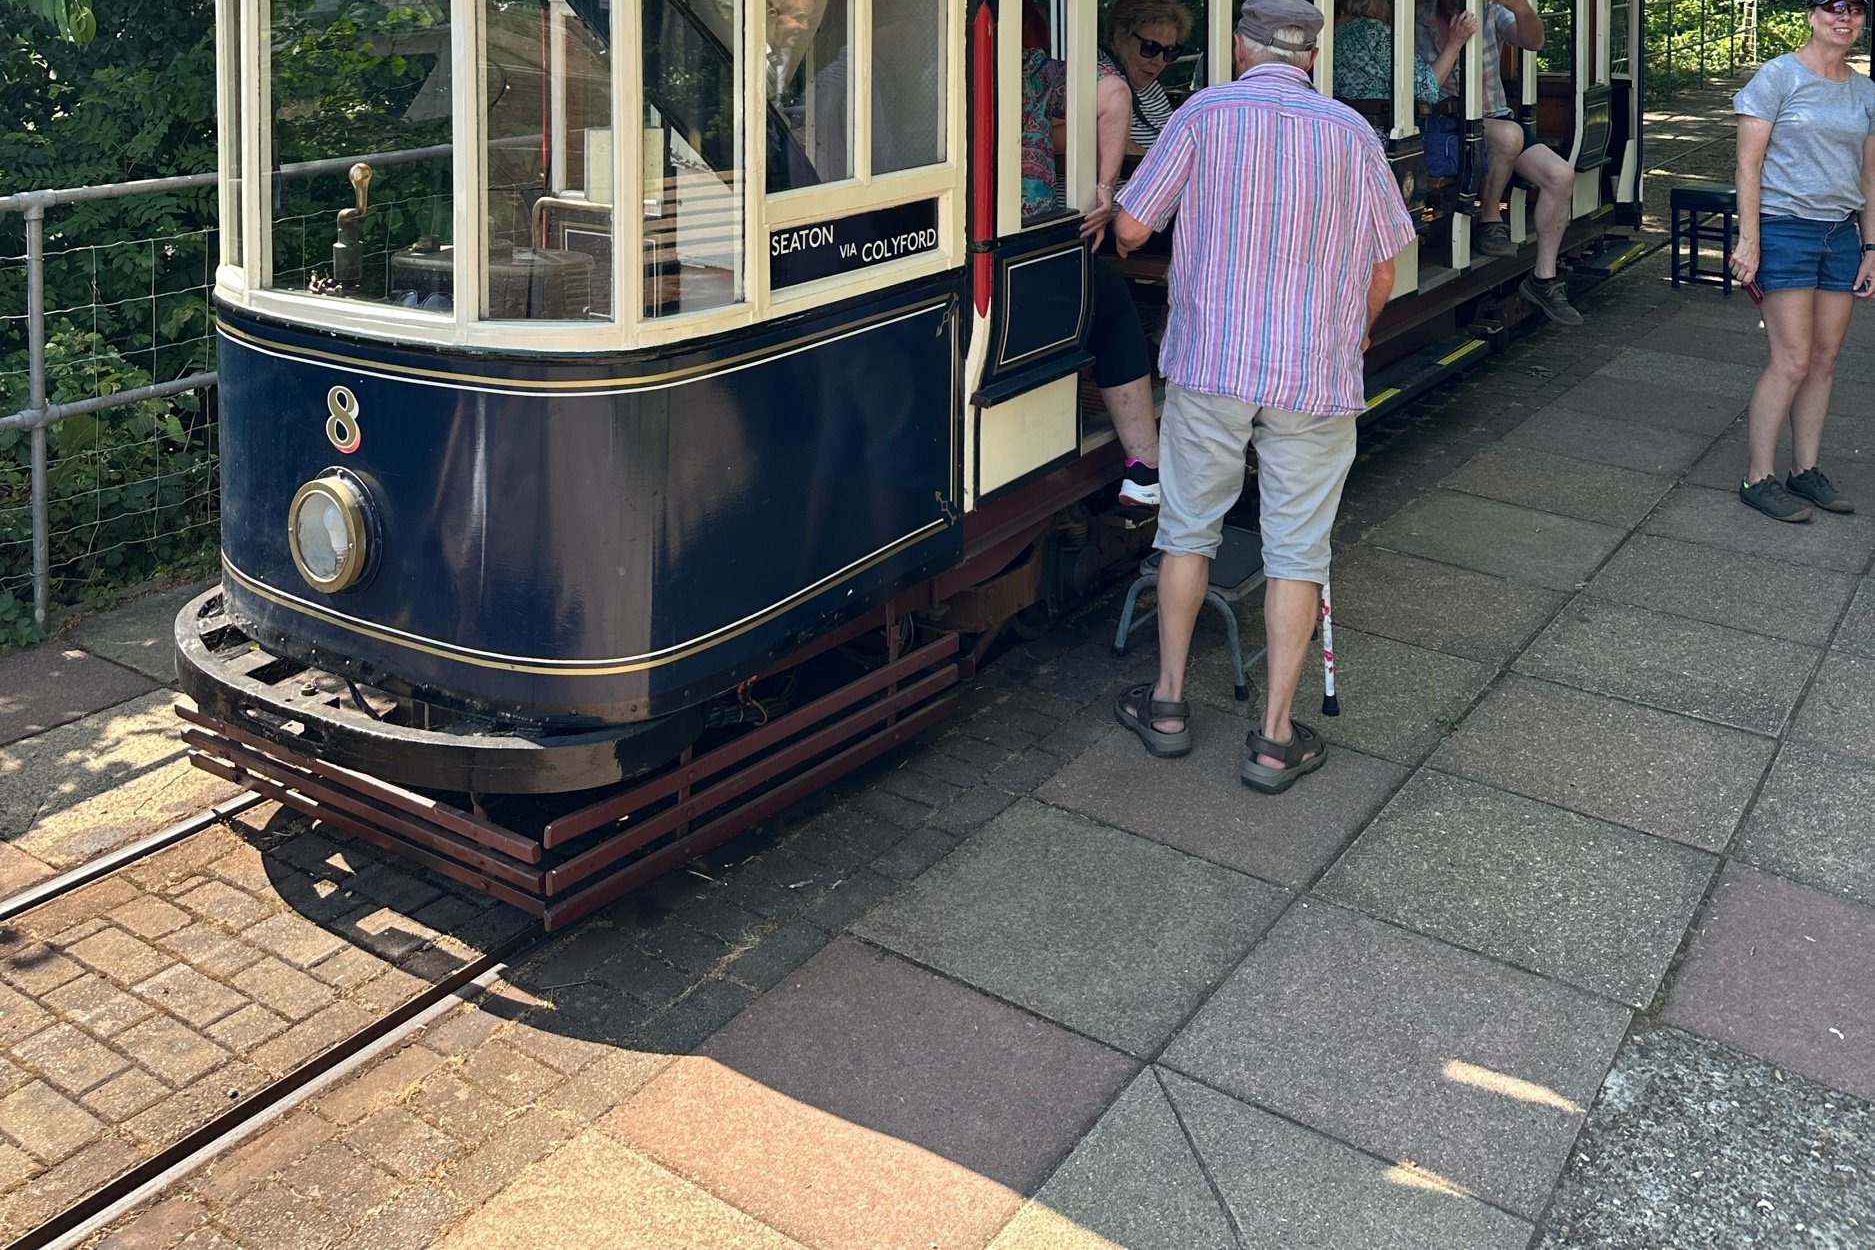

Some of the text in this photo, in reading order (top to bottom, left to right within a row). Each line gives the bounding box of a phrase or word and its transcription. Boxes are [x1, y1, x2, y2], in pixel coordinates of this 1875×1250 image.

[771, 225, 937, 262] SEATON VIA COLYFORD
[326, 385, 362, 454] 8
